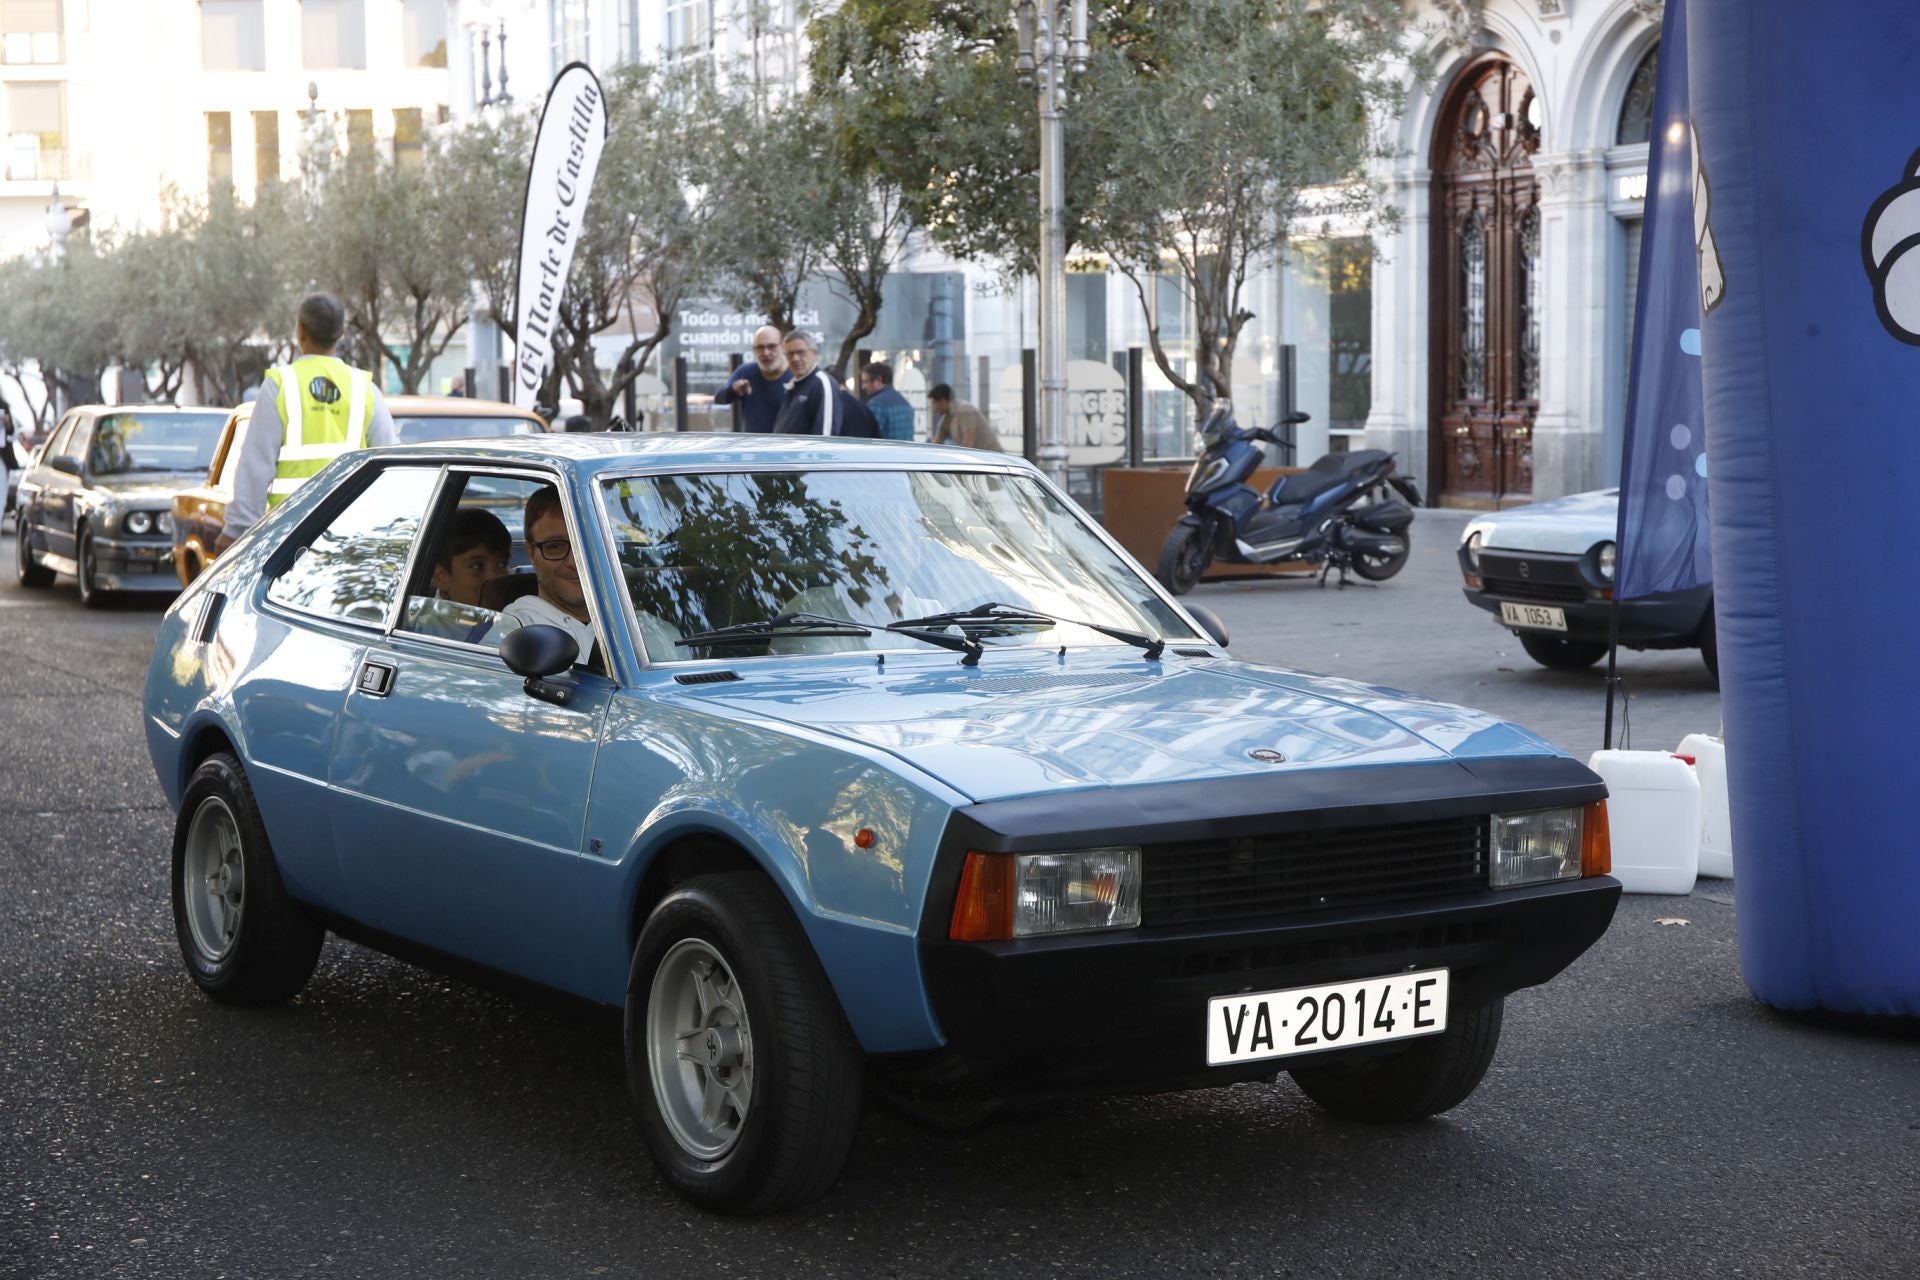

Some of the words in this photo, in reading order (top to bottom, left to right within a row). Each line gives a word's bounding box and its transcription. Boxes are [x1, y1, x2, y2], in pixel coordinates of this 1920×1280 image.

[556, 83, 598, 208] Castilla
[547, 209, 571, 247] de
[527, 246, 562, 338] Norte
[679, 310, 719, 326] Todo
[722, 314, 743, 326] es
[679, 329, 740, 346] cuando
[519, 334, 543, 391] El
[1503, 604, 1520, 622] VA
[1524, 607, 1553, 626] 1053
